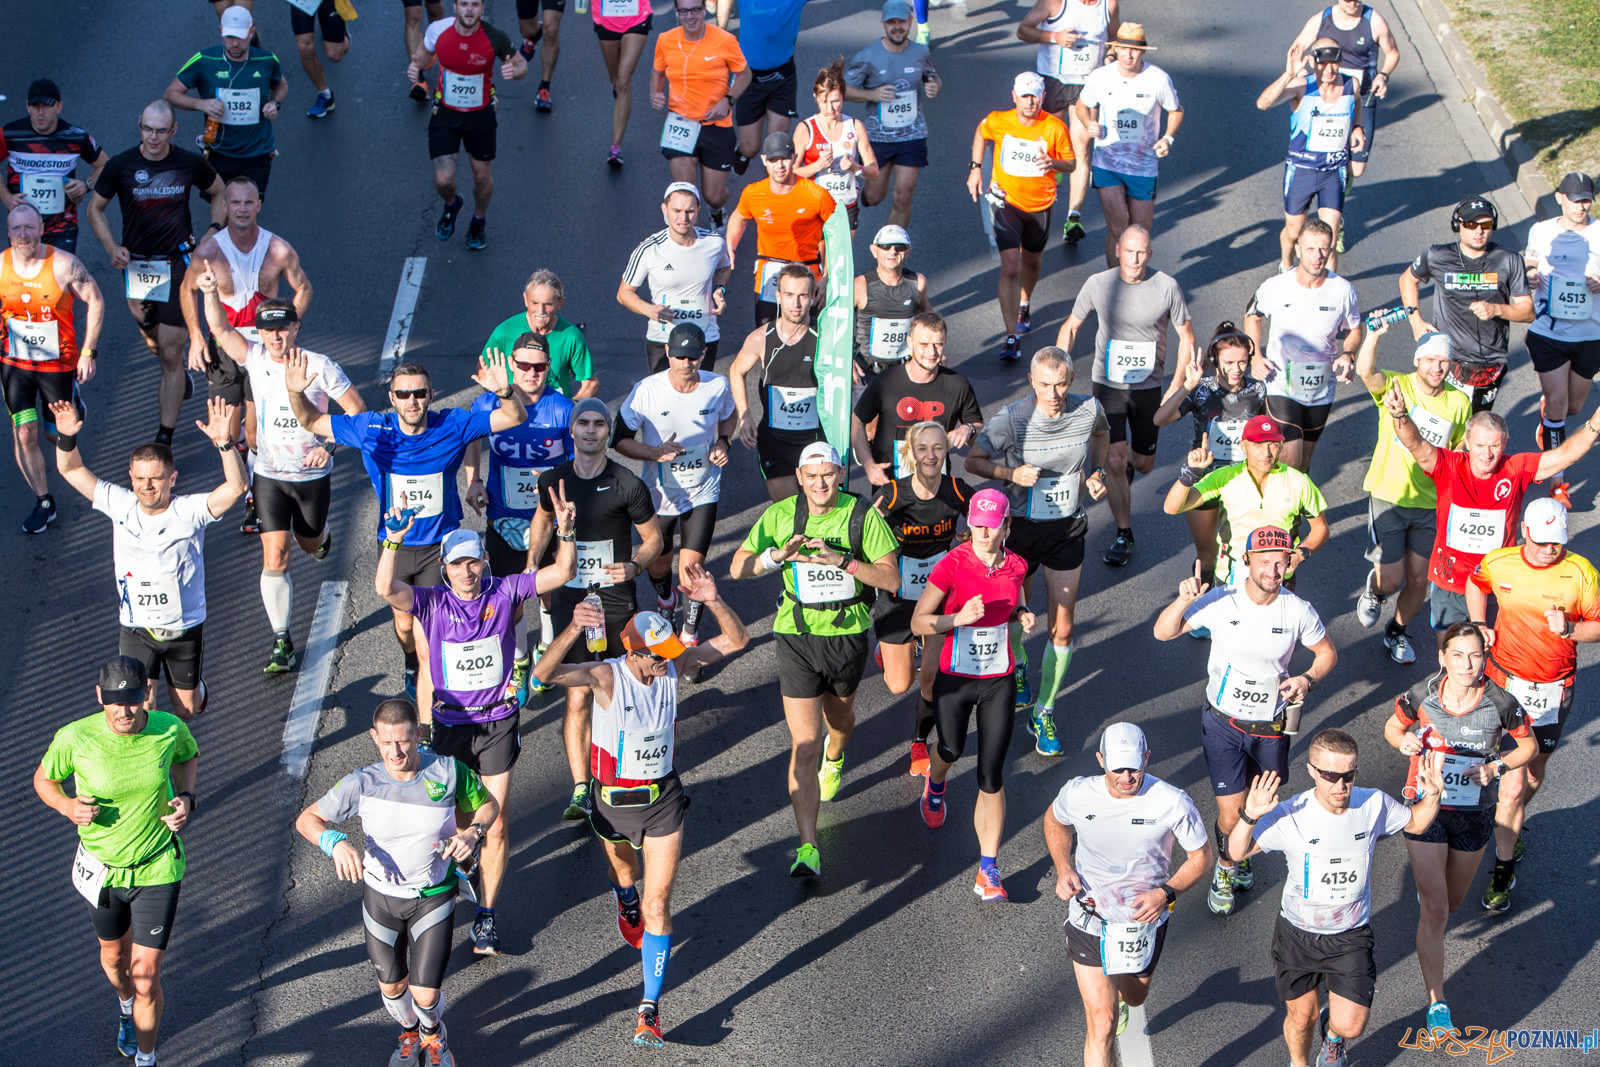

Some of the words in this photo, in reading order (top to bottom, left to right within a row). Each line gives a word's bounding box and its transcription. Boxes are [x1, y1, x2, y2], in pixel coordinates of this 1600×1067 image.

[1073, 53, 1090, 63] 743
[451, 84, 476, 95] 2970
[226, 101, 252, 112] 1382
[887, 103, 912, 114] 4985
[668, 124, 690, 138] 1975
[1318, 127, 1344, 139] 4228
[15, 157, 73, 169] BRIDGESTONE
[826, 180, 852, 191] 5484
[31, 188, 57, 199] 3971
[136, 273, 161, 284] 1877
[1558, 292, 1586, 304] 4513
[672, 309, 703, 319] 2645
[22, 335, 46, 345] 489
[1116, 355, 1147, 367] 2935
[1299, 375, 1325, 386] 1431
[779, 402, 811, 413] 4347
[273, 416, 304, 428] 428
[670, 459, 703, 473] 5645
[516, 481, 537, 493] 24
[1045, 489, 1070, 502] 5111
[903, 522, 930, 536] iron
[933, 519, 952, 536] girl
[1459, 523, 1495, 537] 4205
[1258, 530, 1288, 541] GAME
[1258, 538, 1288, 548] OVER
[577, 557, 602, 569] 291
[807, 569, 844, 582] 5605
[910, 572, 930, 585] 26
[137, 593, 169, 606] 2718
[968, 642, 998, 656] 3132
[455, 655, 494, 672] 4202
[1232, 687, 1270, 704] 3902
[1523, 697, 1549, 710] 341
[634, 744, 669, 761] 1449
[1441, 770, 1471, 786] 618
[1320, 870, 1358, 885] 4136
[1117, 935, 1149, 953] 1324
